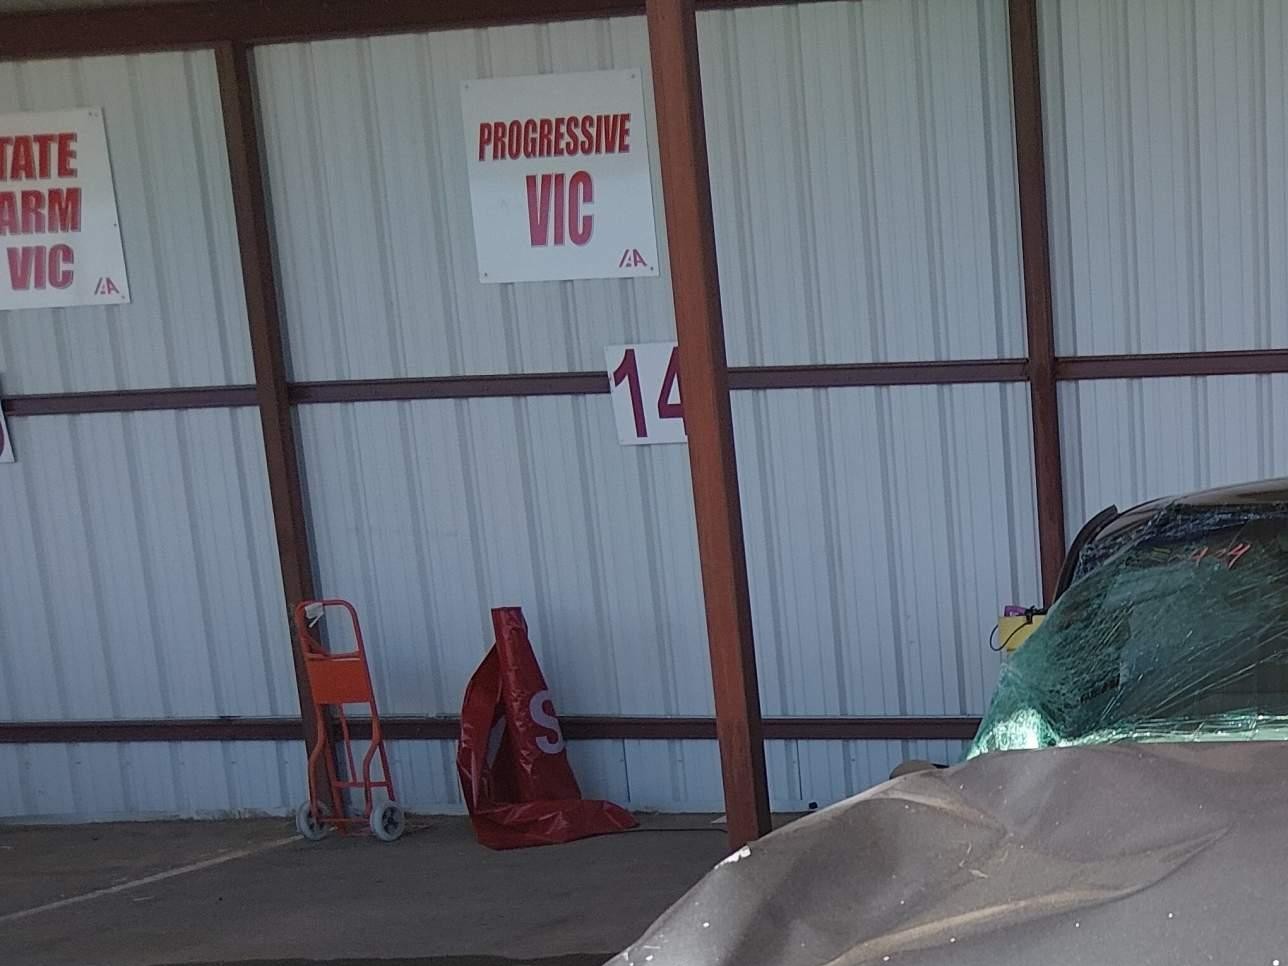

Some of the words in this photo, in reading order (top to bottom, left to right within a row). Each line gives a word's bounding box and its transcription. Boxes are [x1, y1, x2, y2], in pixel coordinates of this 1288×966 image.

[478, 113, 632, 161] PROGRESSIVE
[0, 187, 82, 235] ARM
[525, 170, 594, 247] VIC
[7, 243, 75, 290] VIC
[613, 346, 689, 438] 14
